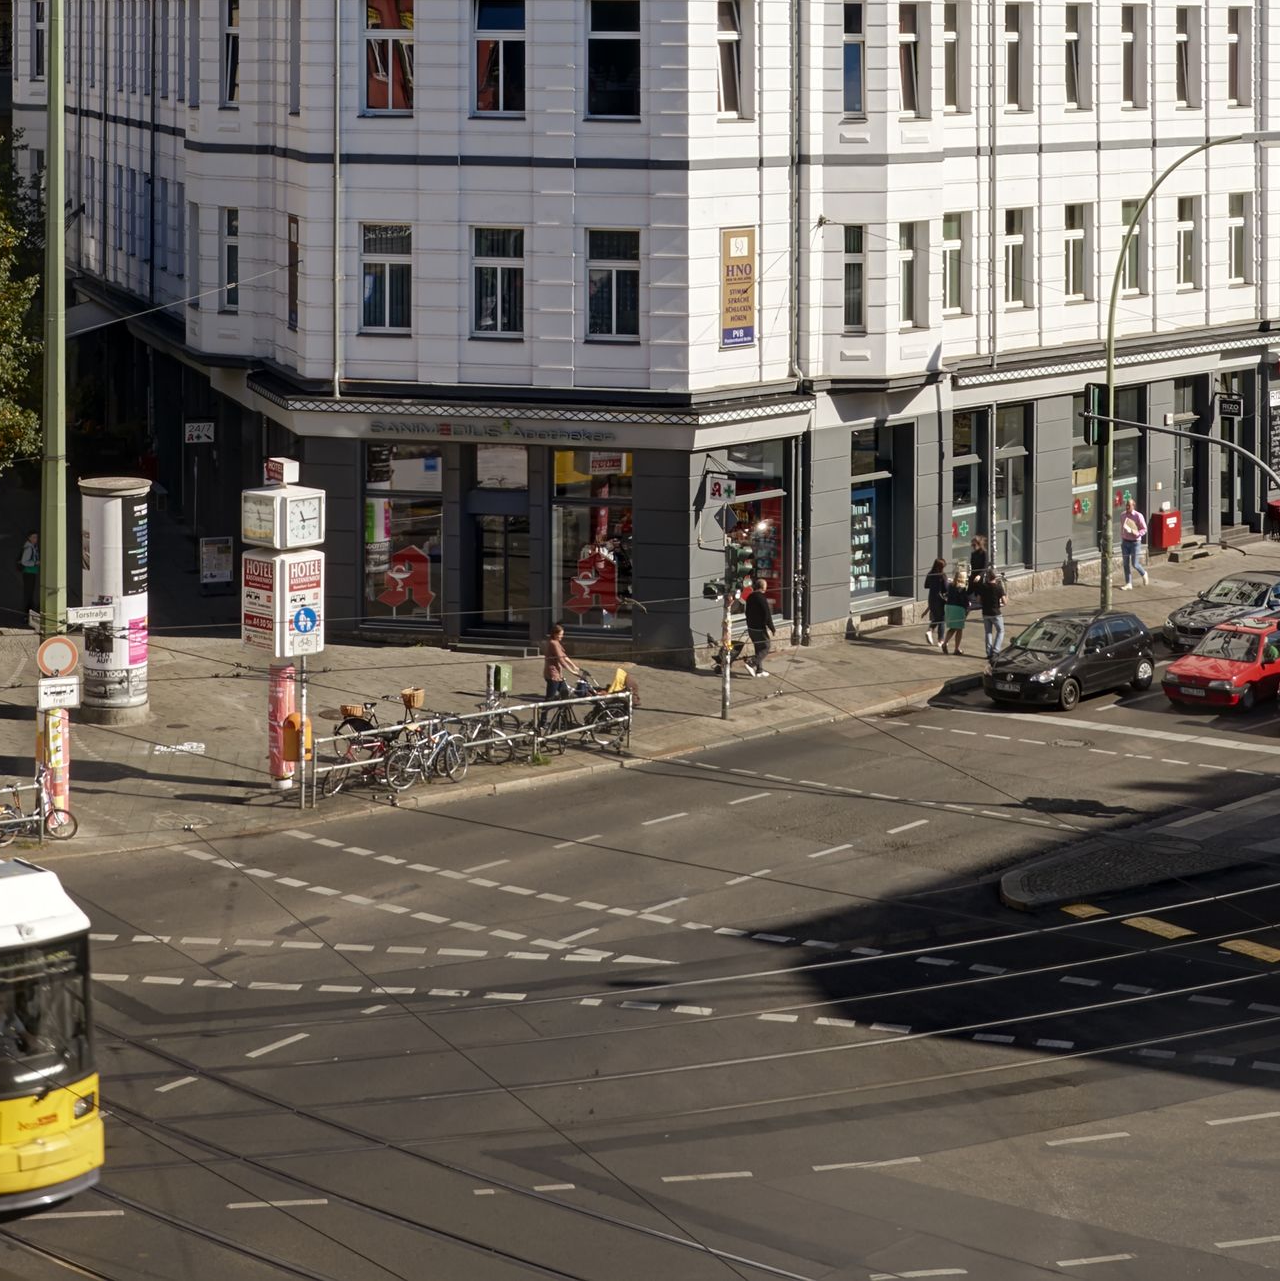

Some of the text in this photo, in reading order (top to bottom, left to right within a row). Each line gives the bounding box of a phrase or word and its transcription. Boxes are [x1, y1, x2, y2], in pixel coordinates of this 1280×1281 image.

[726, 263, 752, 277] HNO
[268, 462, 283, 473] HOTEL
[246, 559, 273, 578] HOTEL
[290, 560, 320, 579] HOTEL
[106, 670, 128, 678] YOGA
